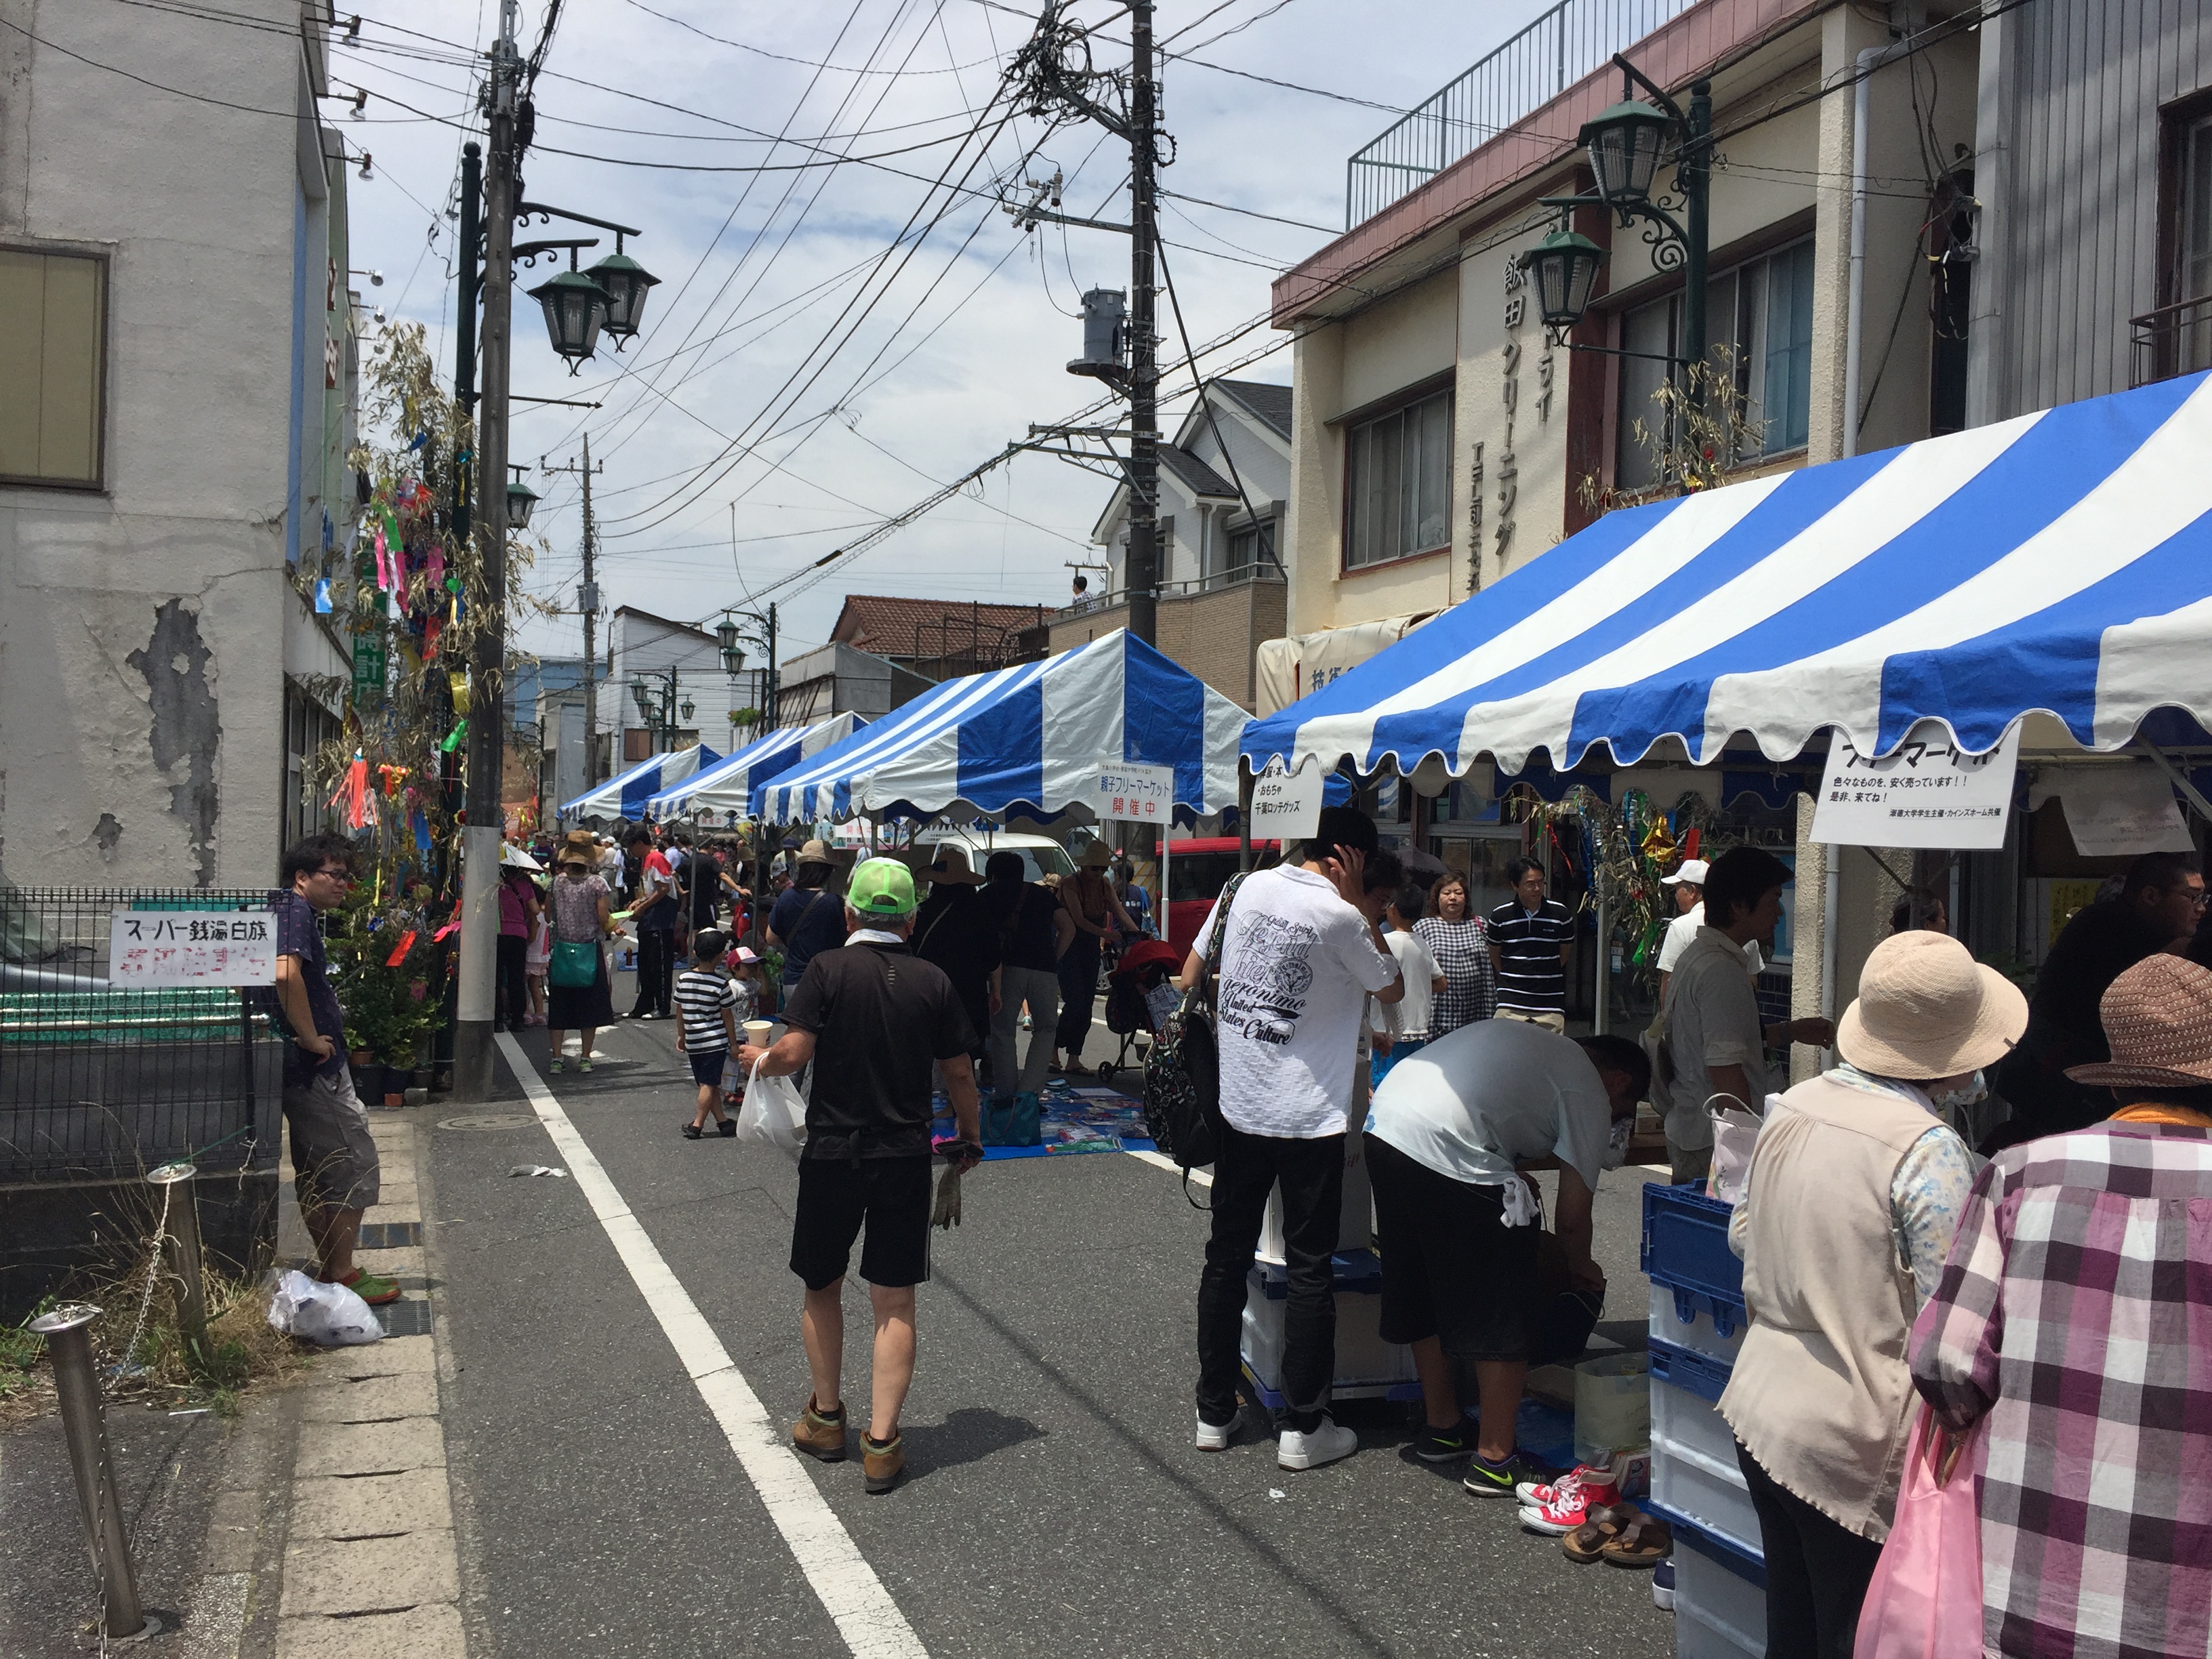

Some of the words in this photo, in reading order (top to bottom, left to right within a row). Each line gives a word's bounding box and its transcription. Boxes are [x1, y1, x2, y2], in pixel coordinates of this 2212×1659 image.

[1494, 253, 1526, 557] 飯田クリーニング
[1101, 775, 1170, 797] 親子フリーマーケット
[1112, 797, 1155, 816] 開催中
[1254, 800, 1301, 815] 千葉ロッテグッズ
[124, 919, 269, 941] スーパー銭湯白旗
[1236, 909, 1317, 963] Legend
[1218, 1002, 1246, 1028] States
[1243, 1019, 1296, 1045] Culture
